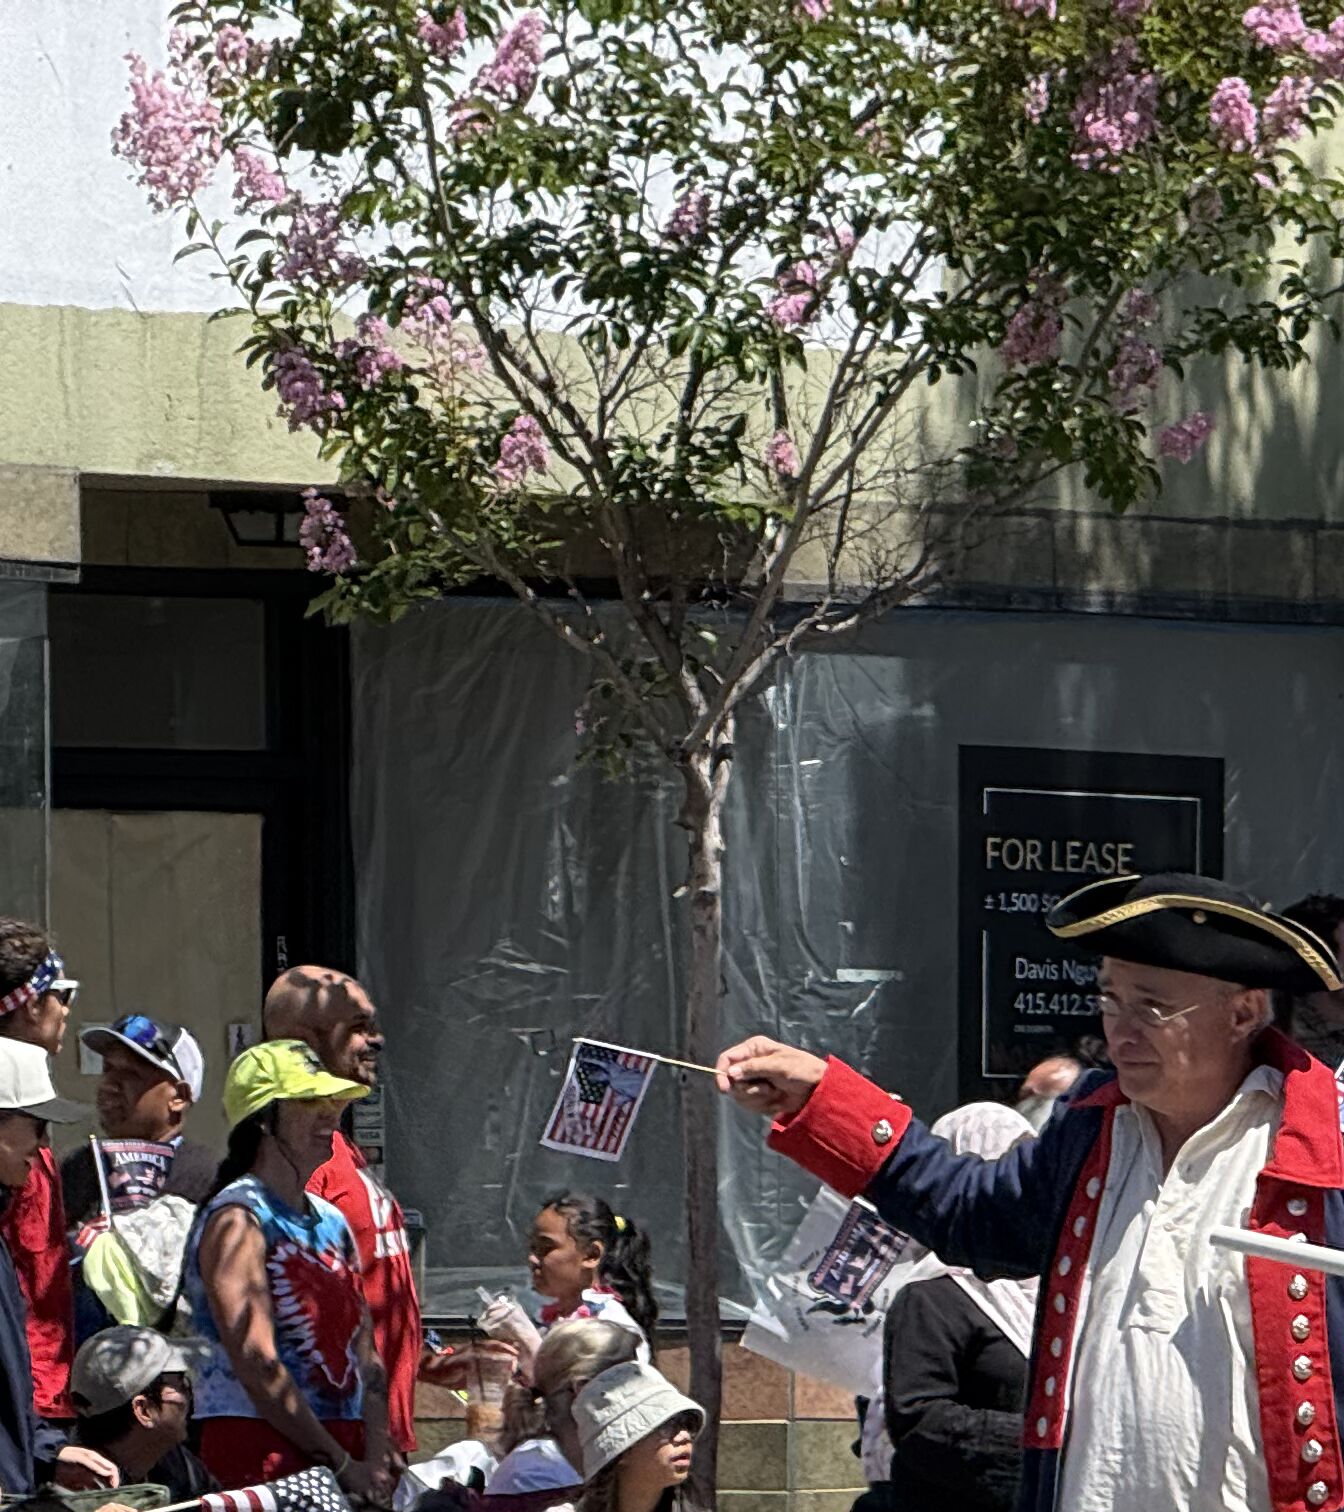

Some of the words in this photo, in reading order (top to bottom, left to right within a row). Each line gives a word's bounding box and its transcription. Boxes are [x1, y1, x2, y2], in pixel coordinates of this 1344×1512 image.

[985, 837, 1042, 872] FOR
[1051, 840, 1136, 875] LEASE
[998, 892, 1039, 913] 1,500
[1015, 957, 1059, 981] Davis
[113, 1151, 166, 1171] AMERICA
